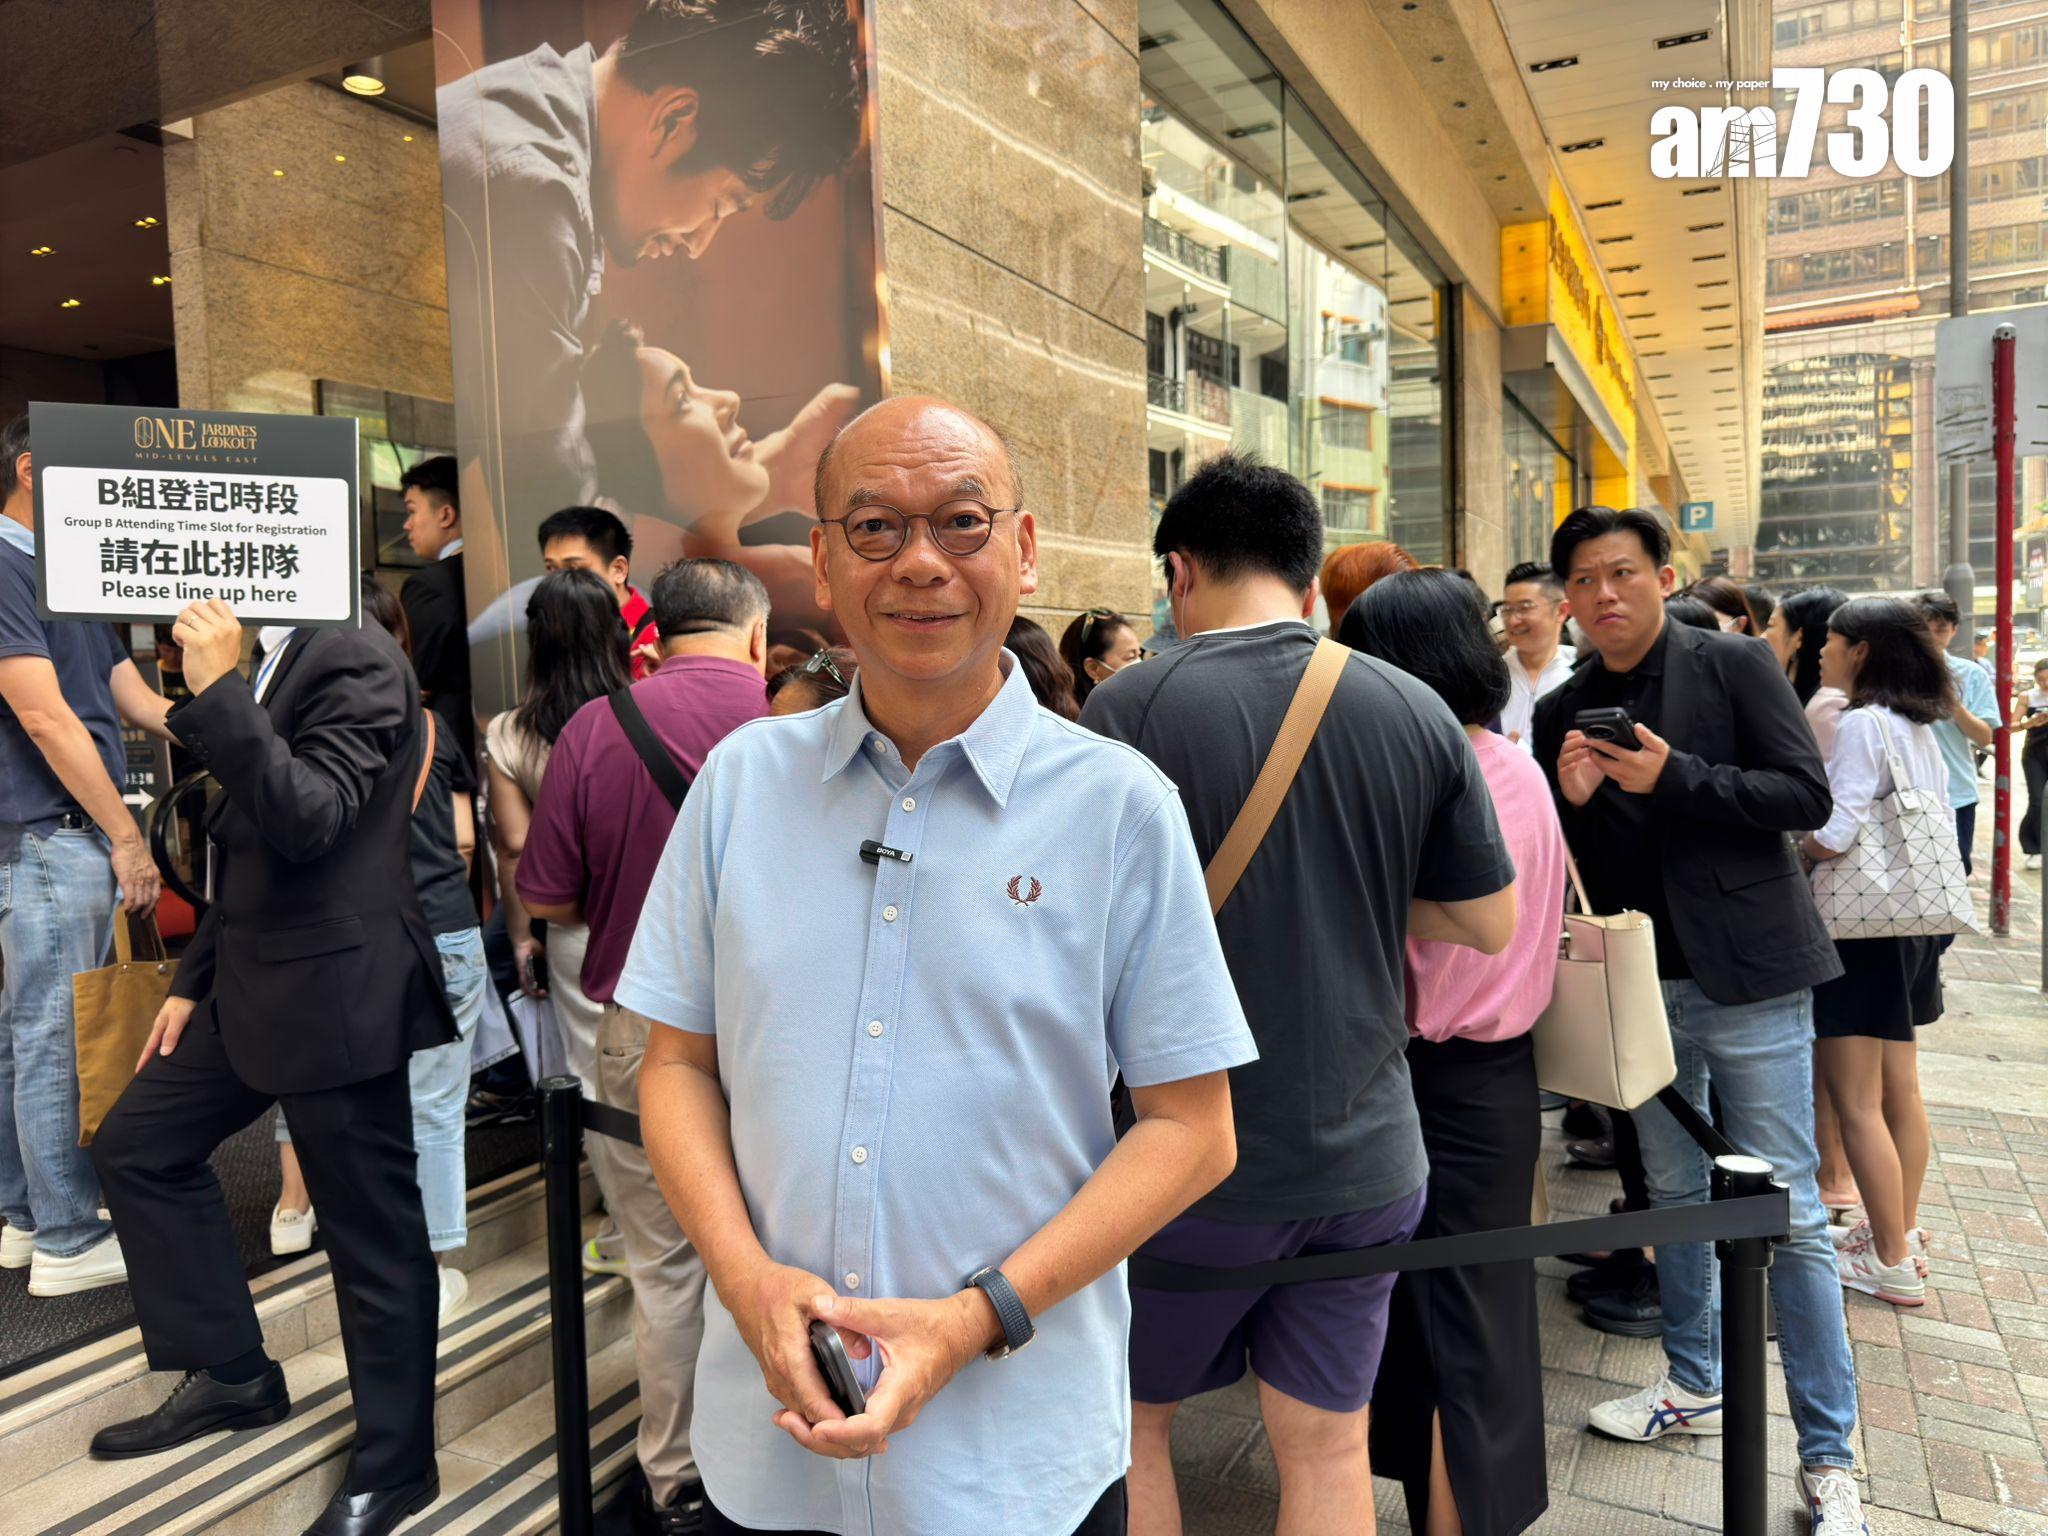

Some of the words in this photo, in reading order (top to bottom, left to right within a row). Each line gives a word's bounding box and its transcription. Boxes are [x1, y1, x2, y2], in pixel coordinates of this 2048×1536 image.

[134, 416, 197, 450] ONE
[201, 435, 257, 450] LOOKOUT
[135, 452, 217, 462] MID-LEVELS
[226, 456, 257, 464] EAST
[97, 476, 299, 516] B組登記時段
[64, 516, 102, 529] Group
[105, 518, 113, 528] B
[115, 518, 175, 532] Attending
[177, 521, 208, 532] Time
[210, 521, 234, 532] Slot
[236, 522, 254, 533] for
[255, 523, 327, 536] Registration
[1690, 506, 1706, 526] P
[99, 537, 300, 579] 請在此排隊
[102, 581, 170, 599] Please
[176, 582, 214, 600] line
[219, 588, 246, 604] up
[252, 585, 297, 603] here
[876, 847, 895, 856] BOYA
